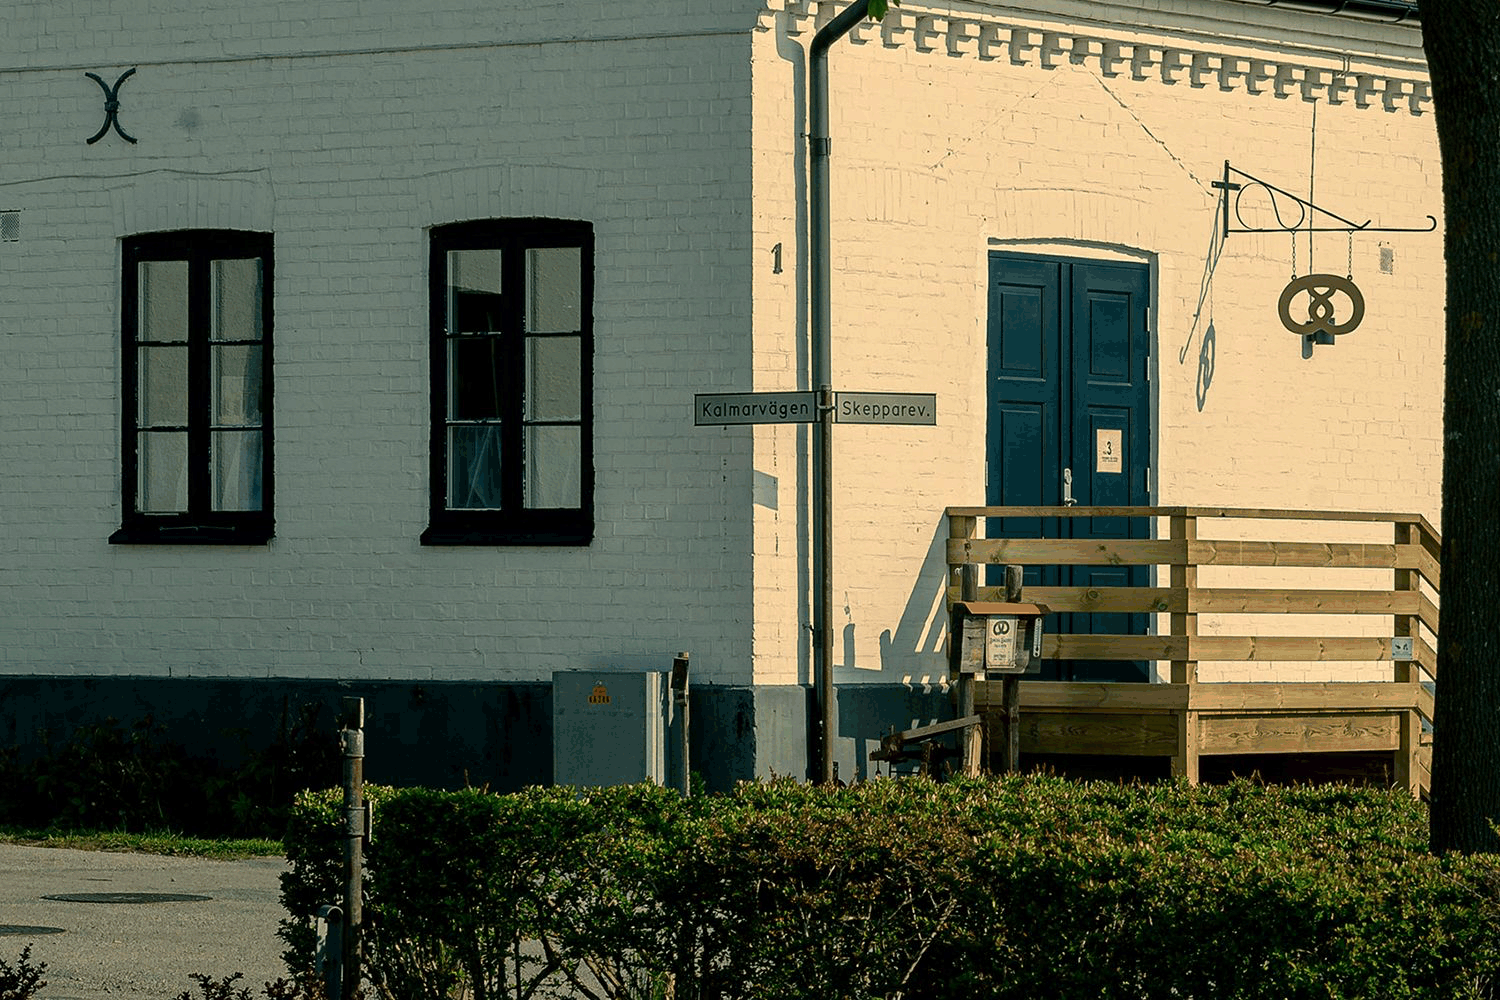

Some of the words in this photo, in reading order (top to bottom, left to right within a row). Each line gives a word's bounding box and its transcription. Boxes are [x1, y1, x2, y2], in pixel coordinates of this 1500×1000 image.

[770, 242, 784, 275] 1
[702, 401, 809, 418] Kalmarvägen
[842, 400, 931, 419] Skepparev.
